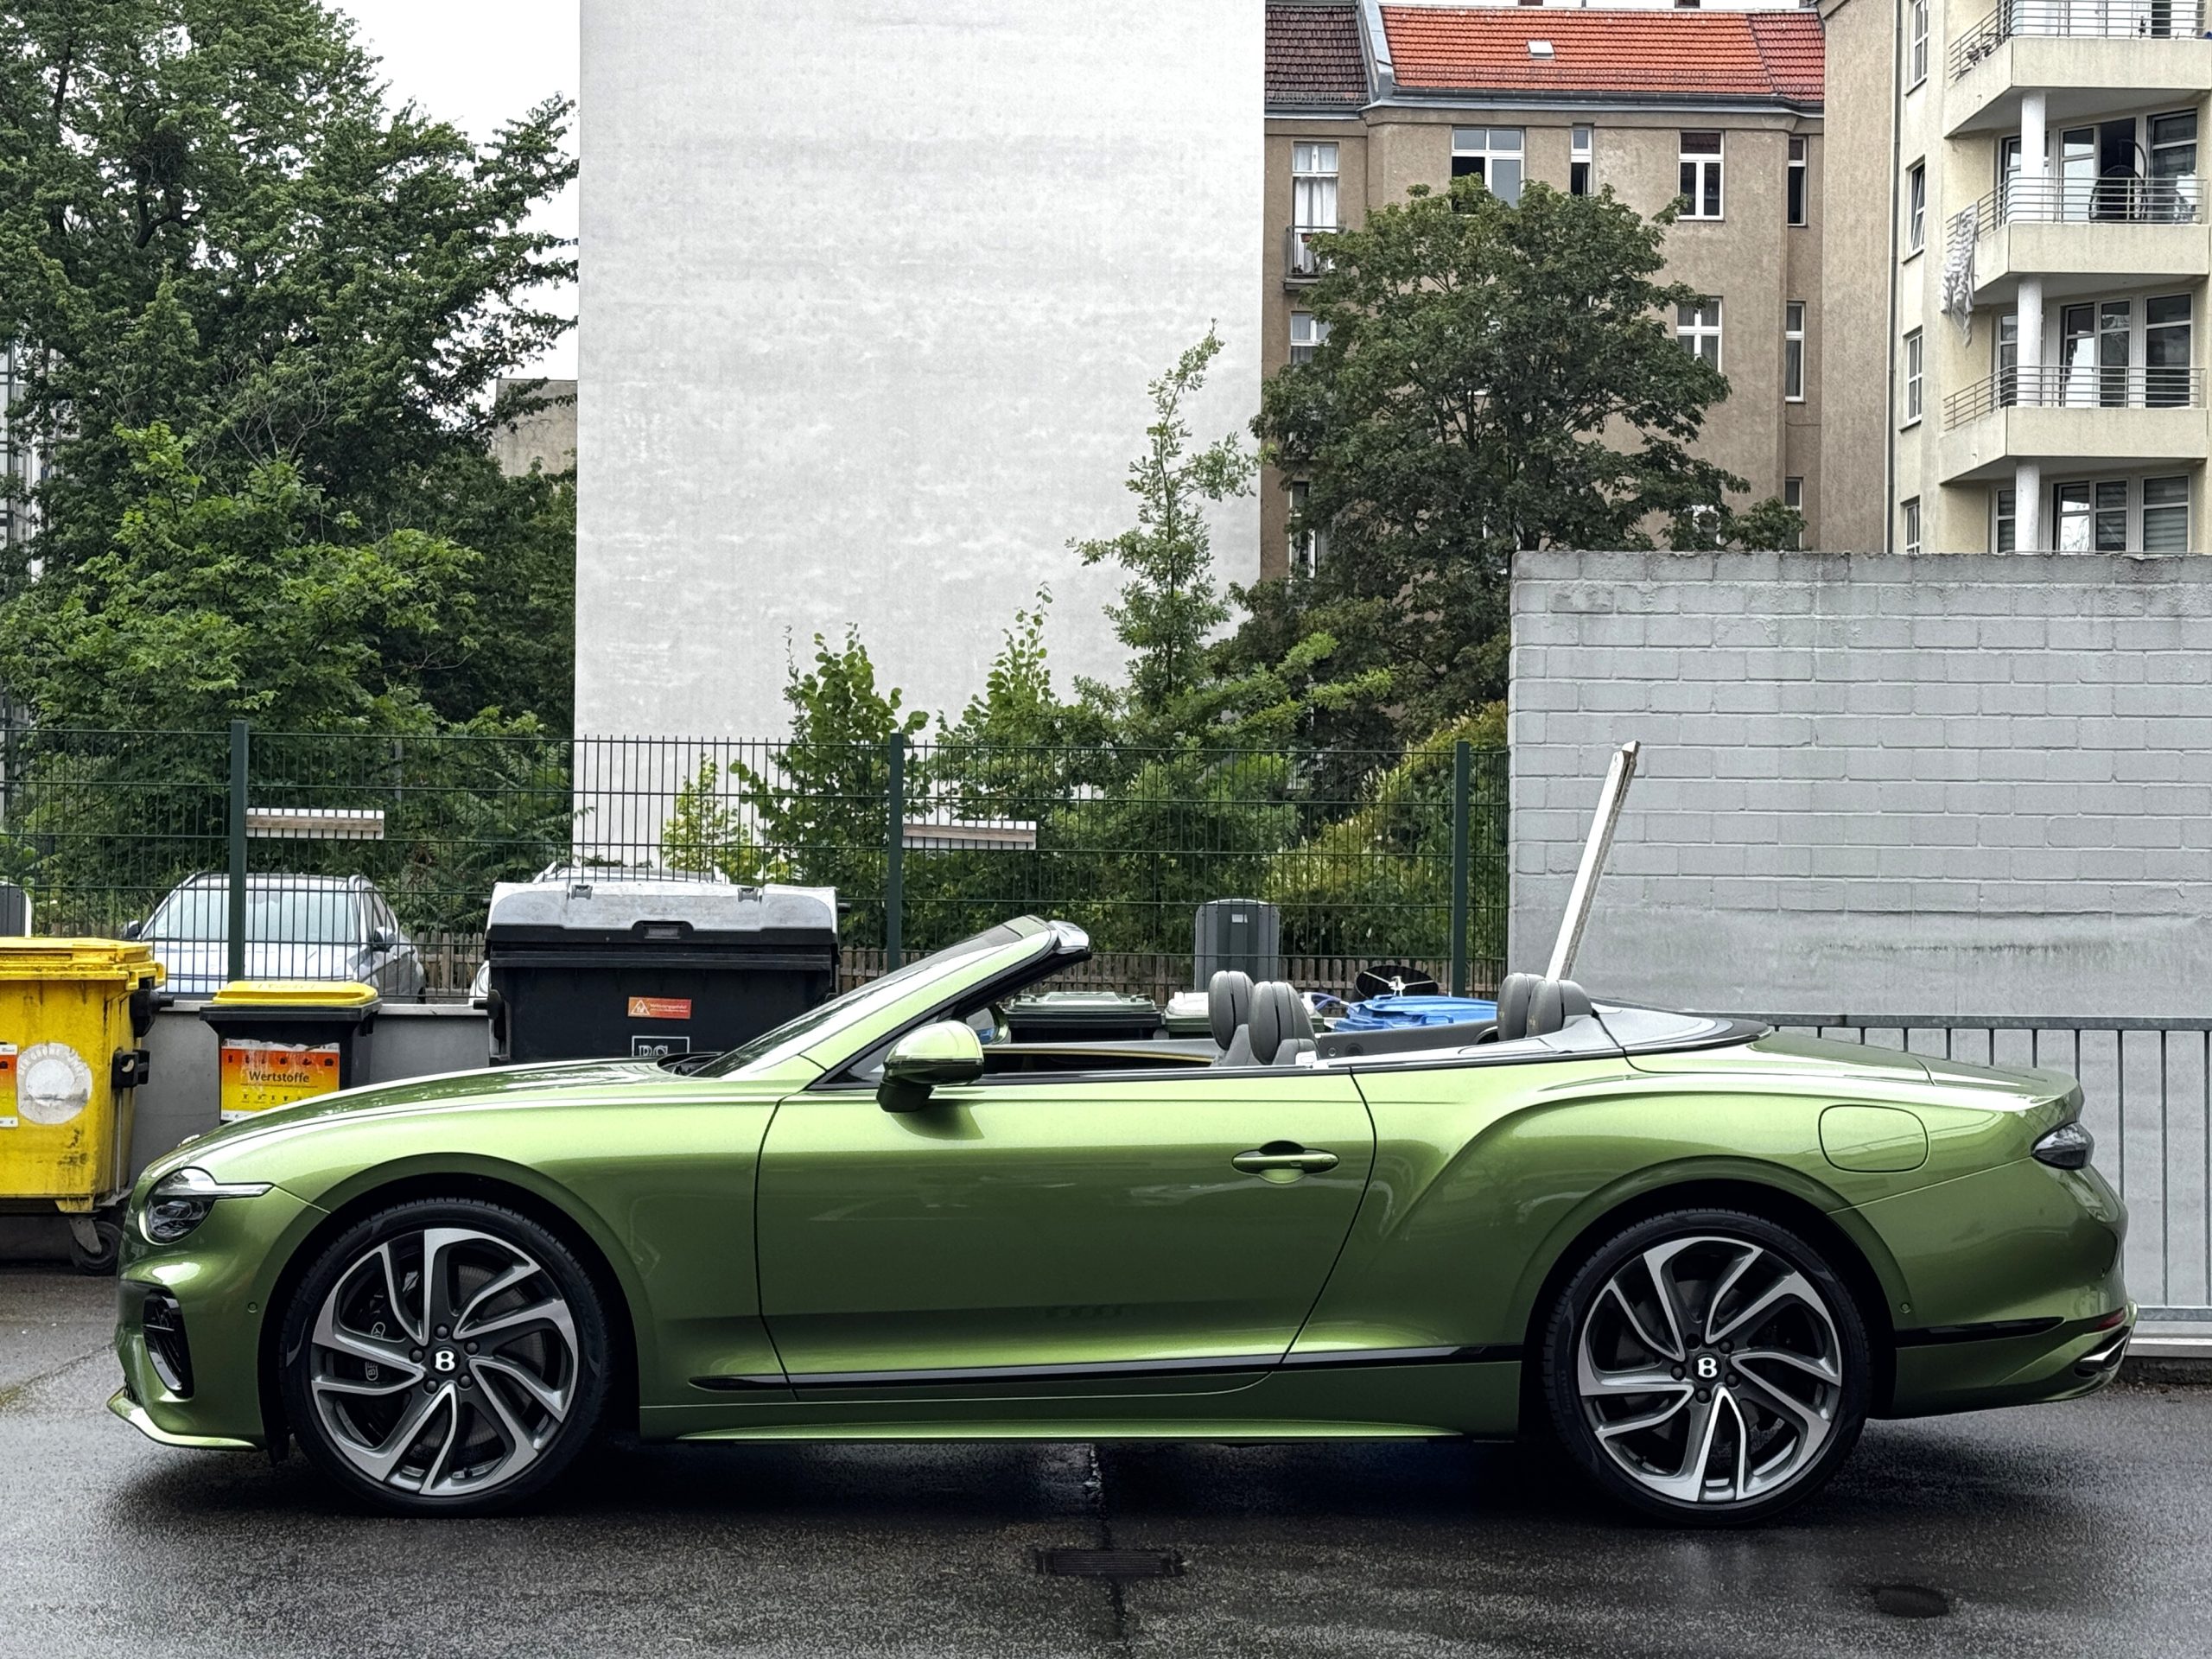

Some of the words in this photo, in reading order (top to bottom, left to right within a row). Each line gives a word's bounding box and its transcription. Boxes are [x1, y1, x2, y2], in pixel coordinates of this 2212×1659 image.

[249, 1071, 309, 1083] Wertstoffe
[435, 1351, 455, 1371] B
[1698, 1357, 1718, 1378] B
